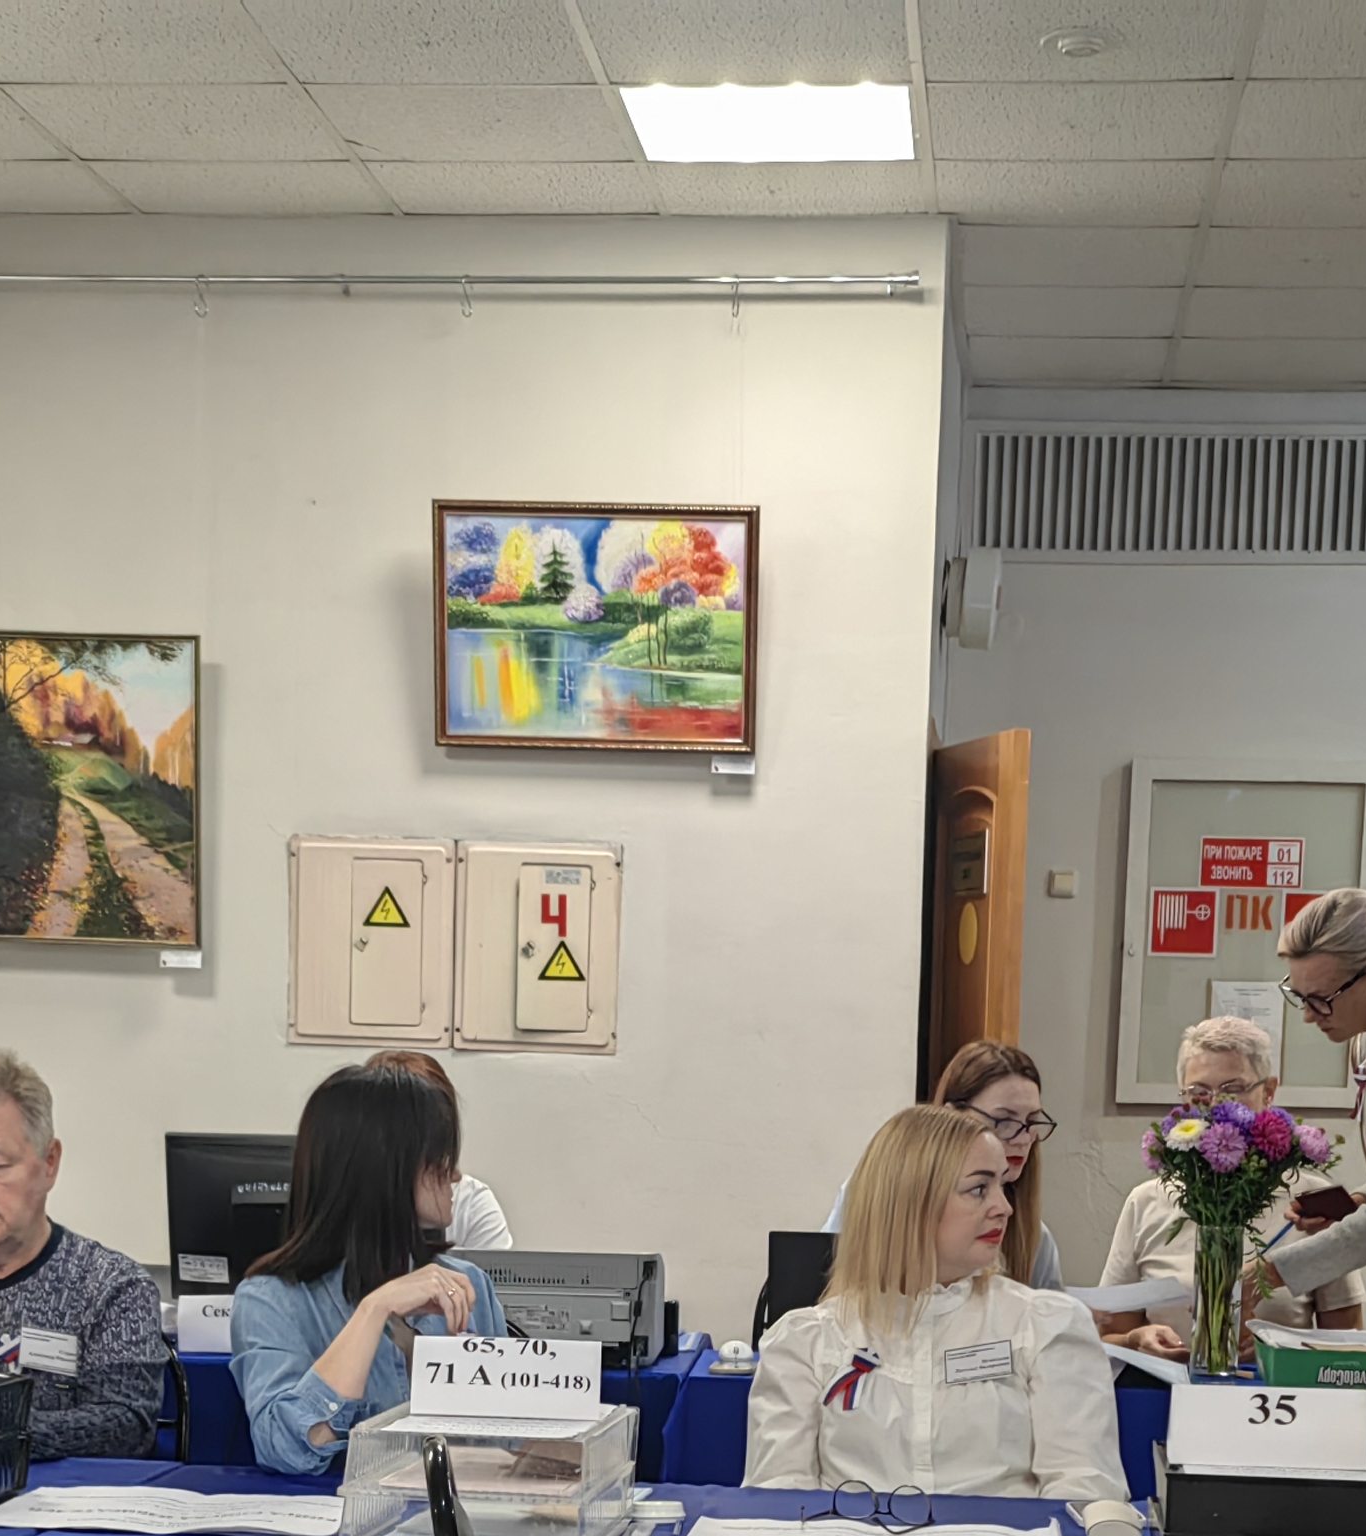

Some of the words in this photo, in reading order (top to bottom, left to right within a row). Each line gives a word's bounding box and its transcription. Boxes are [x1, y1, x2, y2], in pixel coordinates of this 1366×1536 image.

[1204, 845, 1222, 859] ПРИ
[1224, 845, 1263, 860] ПОЖАРЕ
[1277, 848, 1292, 862] 01
[1211, 865, 1253, 880] ЗВОНИТЬ
[1273, 871, 1294, 884] 112
[1225, 894, 1274, 931] ПК
[202, 1304, 230, 1318] Сек
[462, 1338, 504, 1357] 65,
[515, 1339, 557, 1360] 70,
[425, 1362, 456, 1384] 71
[500, 1372, 591, 1393] (101-418)
[1248, 1393, 1297, 1425] 35
